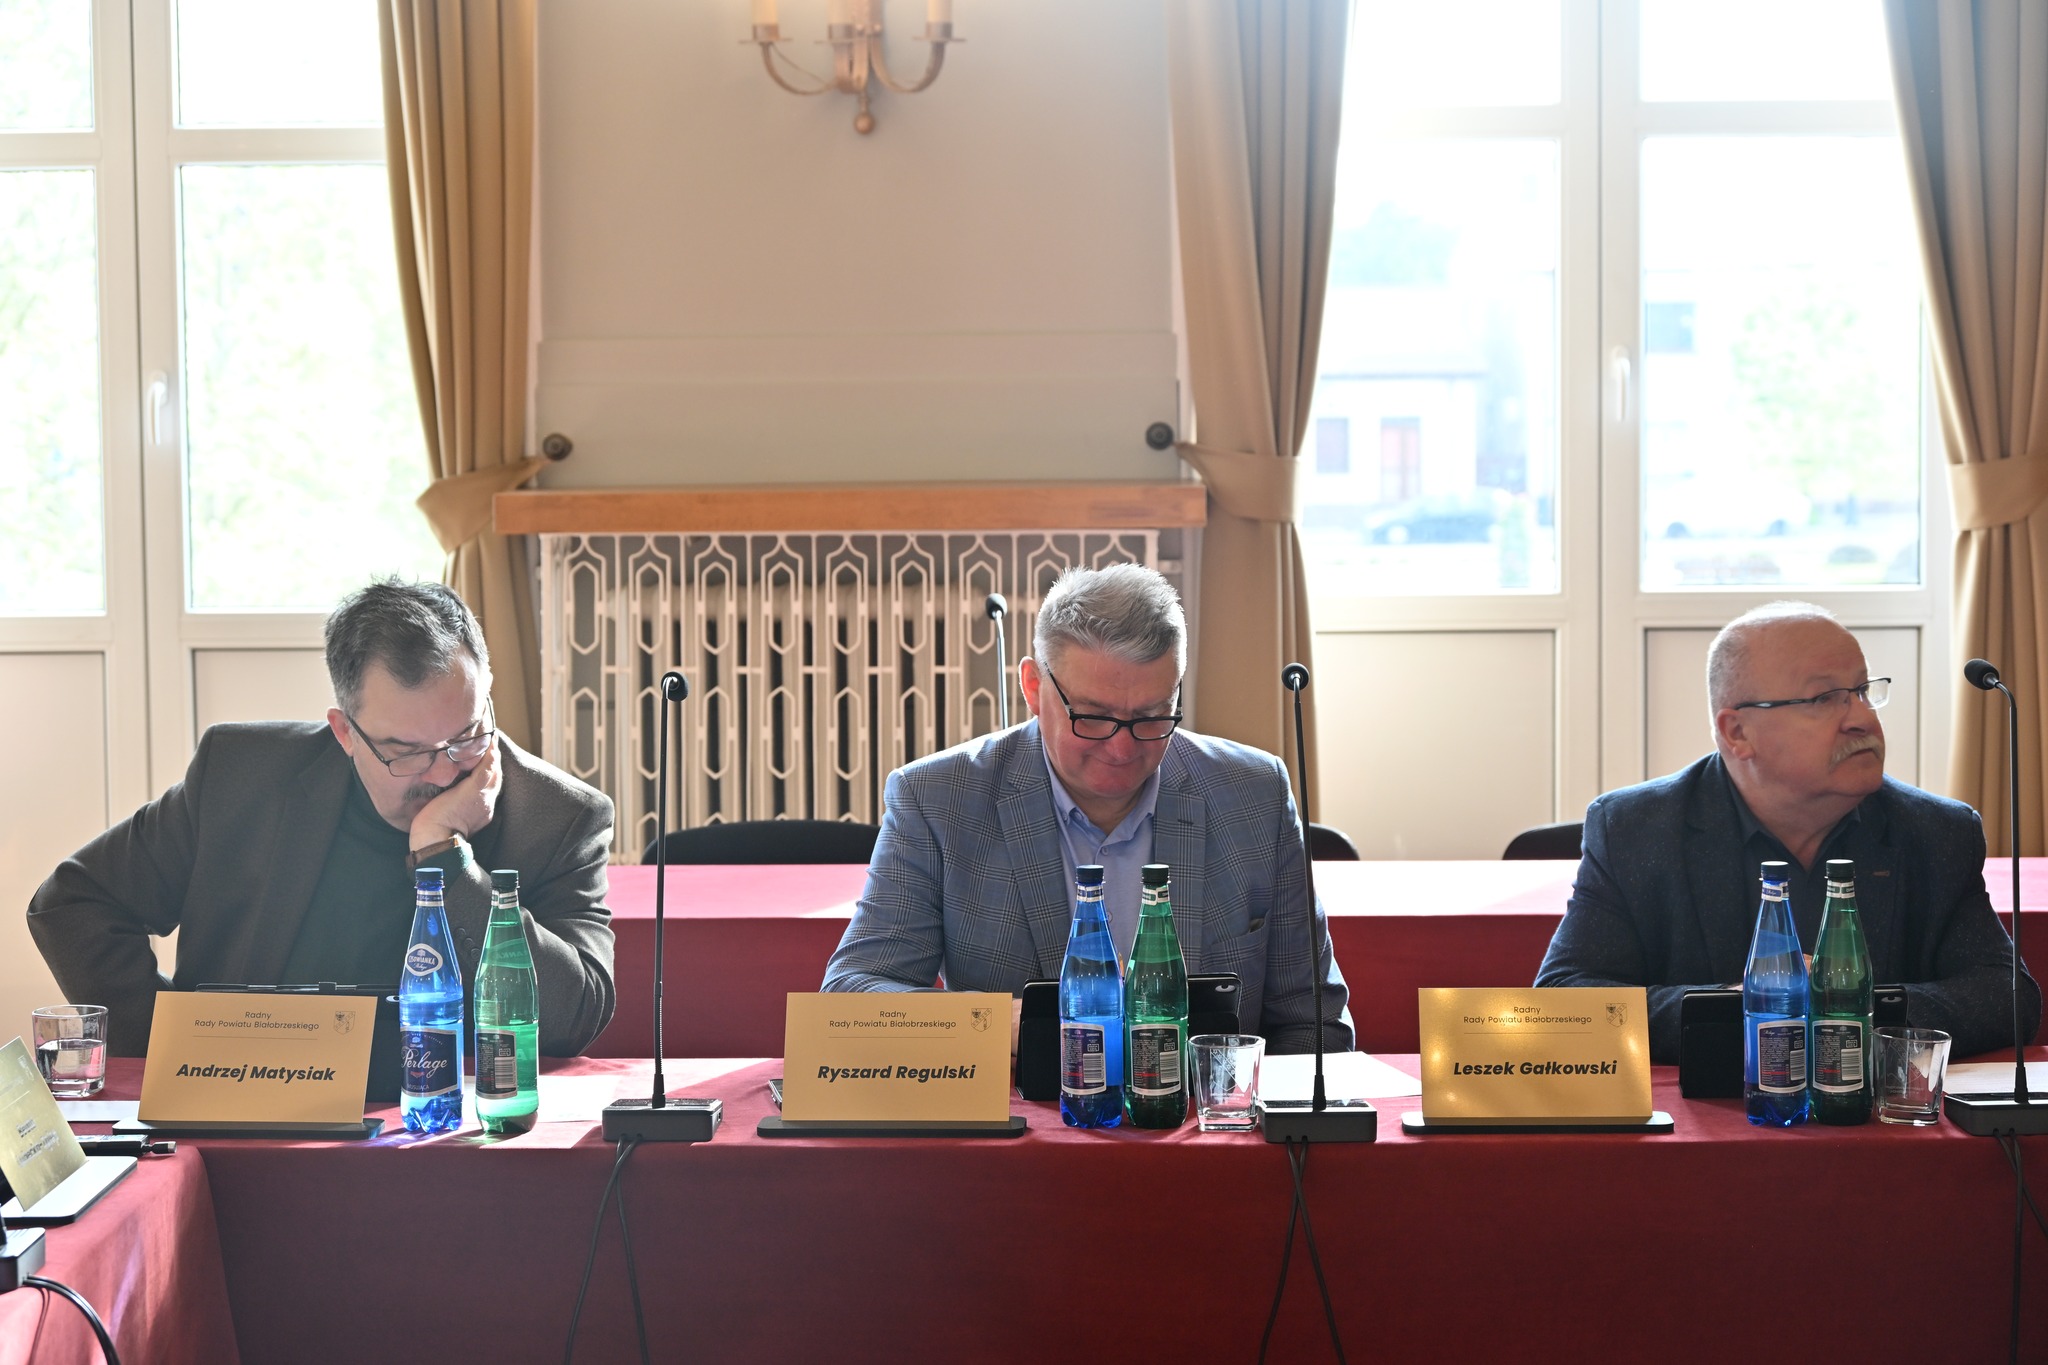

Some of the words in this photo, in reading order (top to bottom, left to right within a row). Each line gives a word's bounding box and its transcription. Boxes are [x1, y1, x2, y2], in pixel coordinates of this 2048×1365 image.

[245, 1011, 272, 1020] Radny
[879, 1010, 907, 1020] Radny
[1513, 1006, 1541, 1015] Radny
[194, 1019, 216, 1029] Rady
[218, 1020, 251, 1028] Powiatu
[254, 1021, 320, 1032] Białobrzeskiego
[829, 1020, 851, 1030] Rady
[853, 1019, 888, 1028] Powiatu
[890, 1019, 957, 1030] Białobrzeskiego
[1463, 1016, 1486, 1025] Rady
[1488, 1015, 1522, 1024] Powiatu
[1525, 1015, 1592, 1025] Białobrzeskiego
[401, 1046, 448, 1079] Perlage
[1453, 1062, 1516, 1076] Leszek
[1519, 1060, 1618, 1075] Gałkowski
[176, 1064, 248, 1083] Andrzej
[249, 1066, 337, 1084] Matysiak
[817, 1065, 893, 1084] Ryszard
[895, 1064, 977, 1084] Regulski
